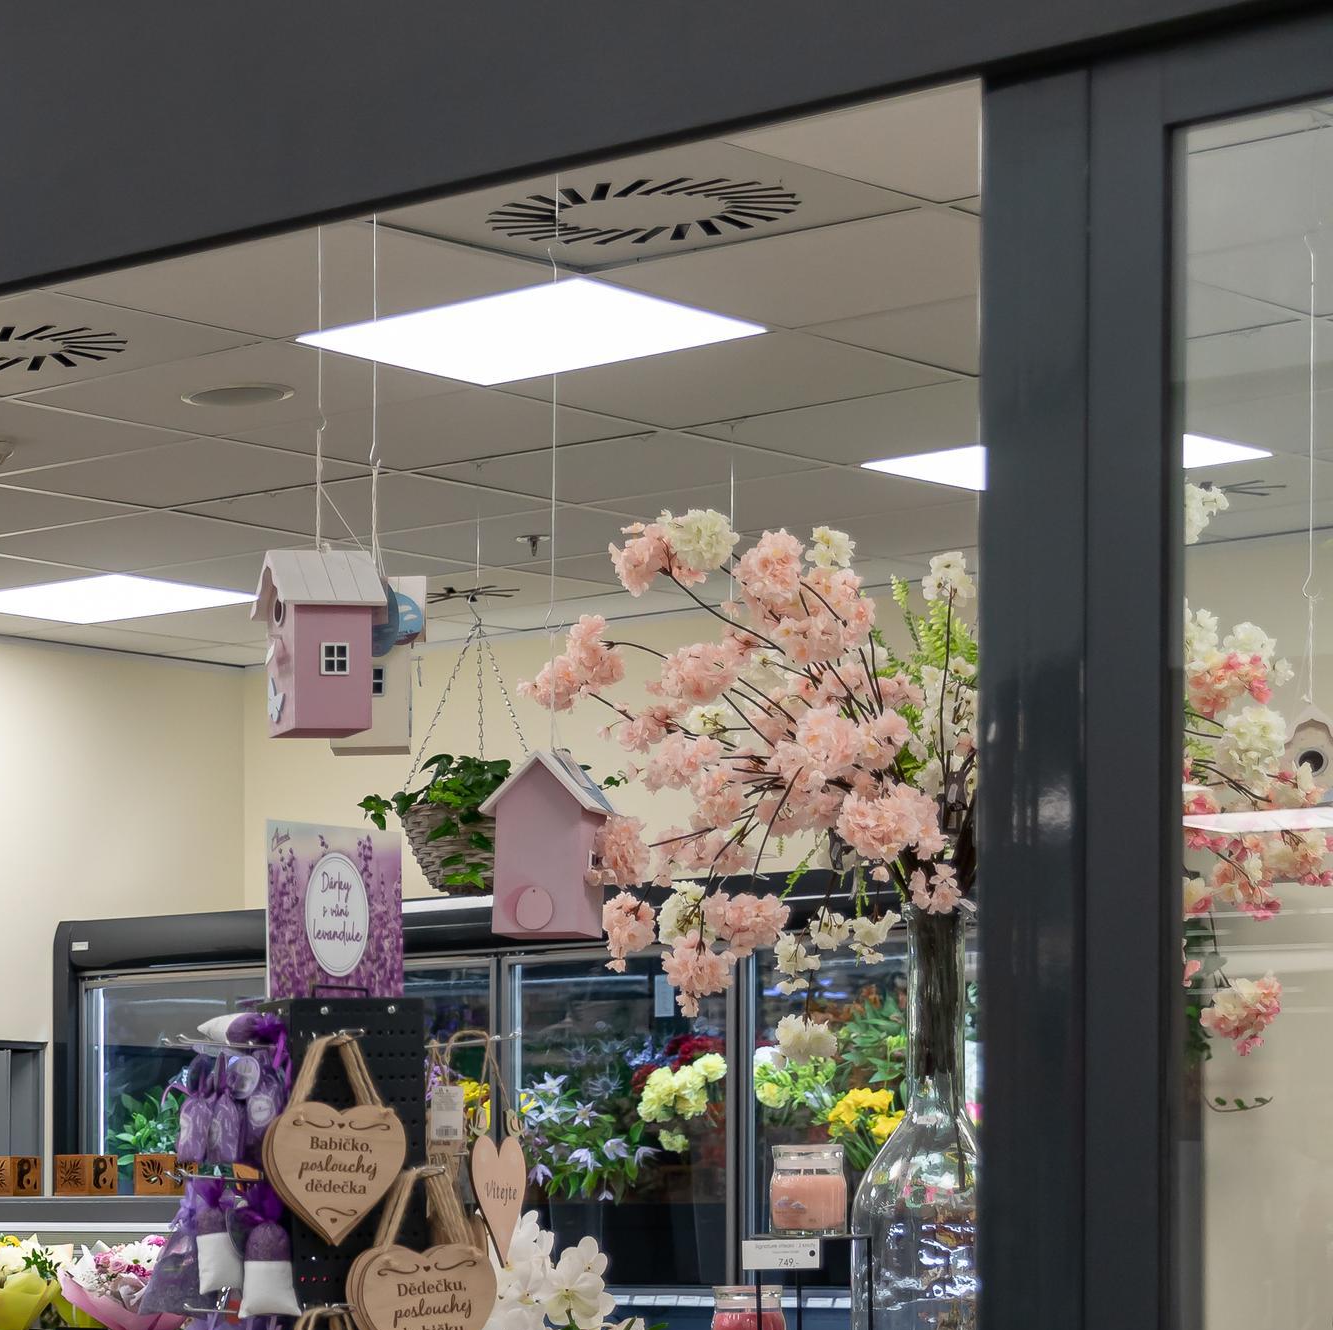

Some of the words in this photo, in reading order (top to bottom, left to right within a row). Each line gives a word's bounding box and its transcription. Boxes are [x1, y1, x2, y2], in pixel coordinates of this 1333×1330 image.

[321, 871, 351, 901] Dárky
[312, 919, 363, 946] levandule
[309, 1136, 373, 1153] Babičko,
[298, 1154, 377, 1180] poslouchej
[305, 1178, 367, 1195] dědečka
[396, 1278, 467, 1297] Dědečku,
[393, 1295, 472, 1328] poslouchej
